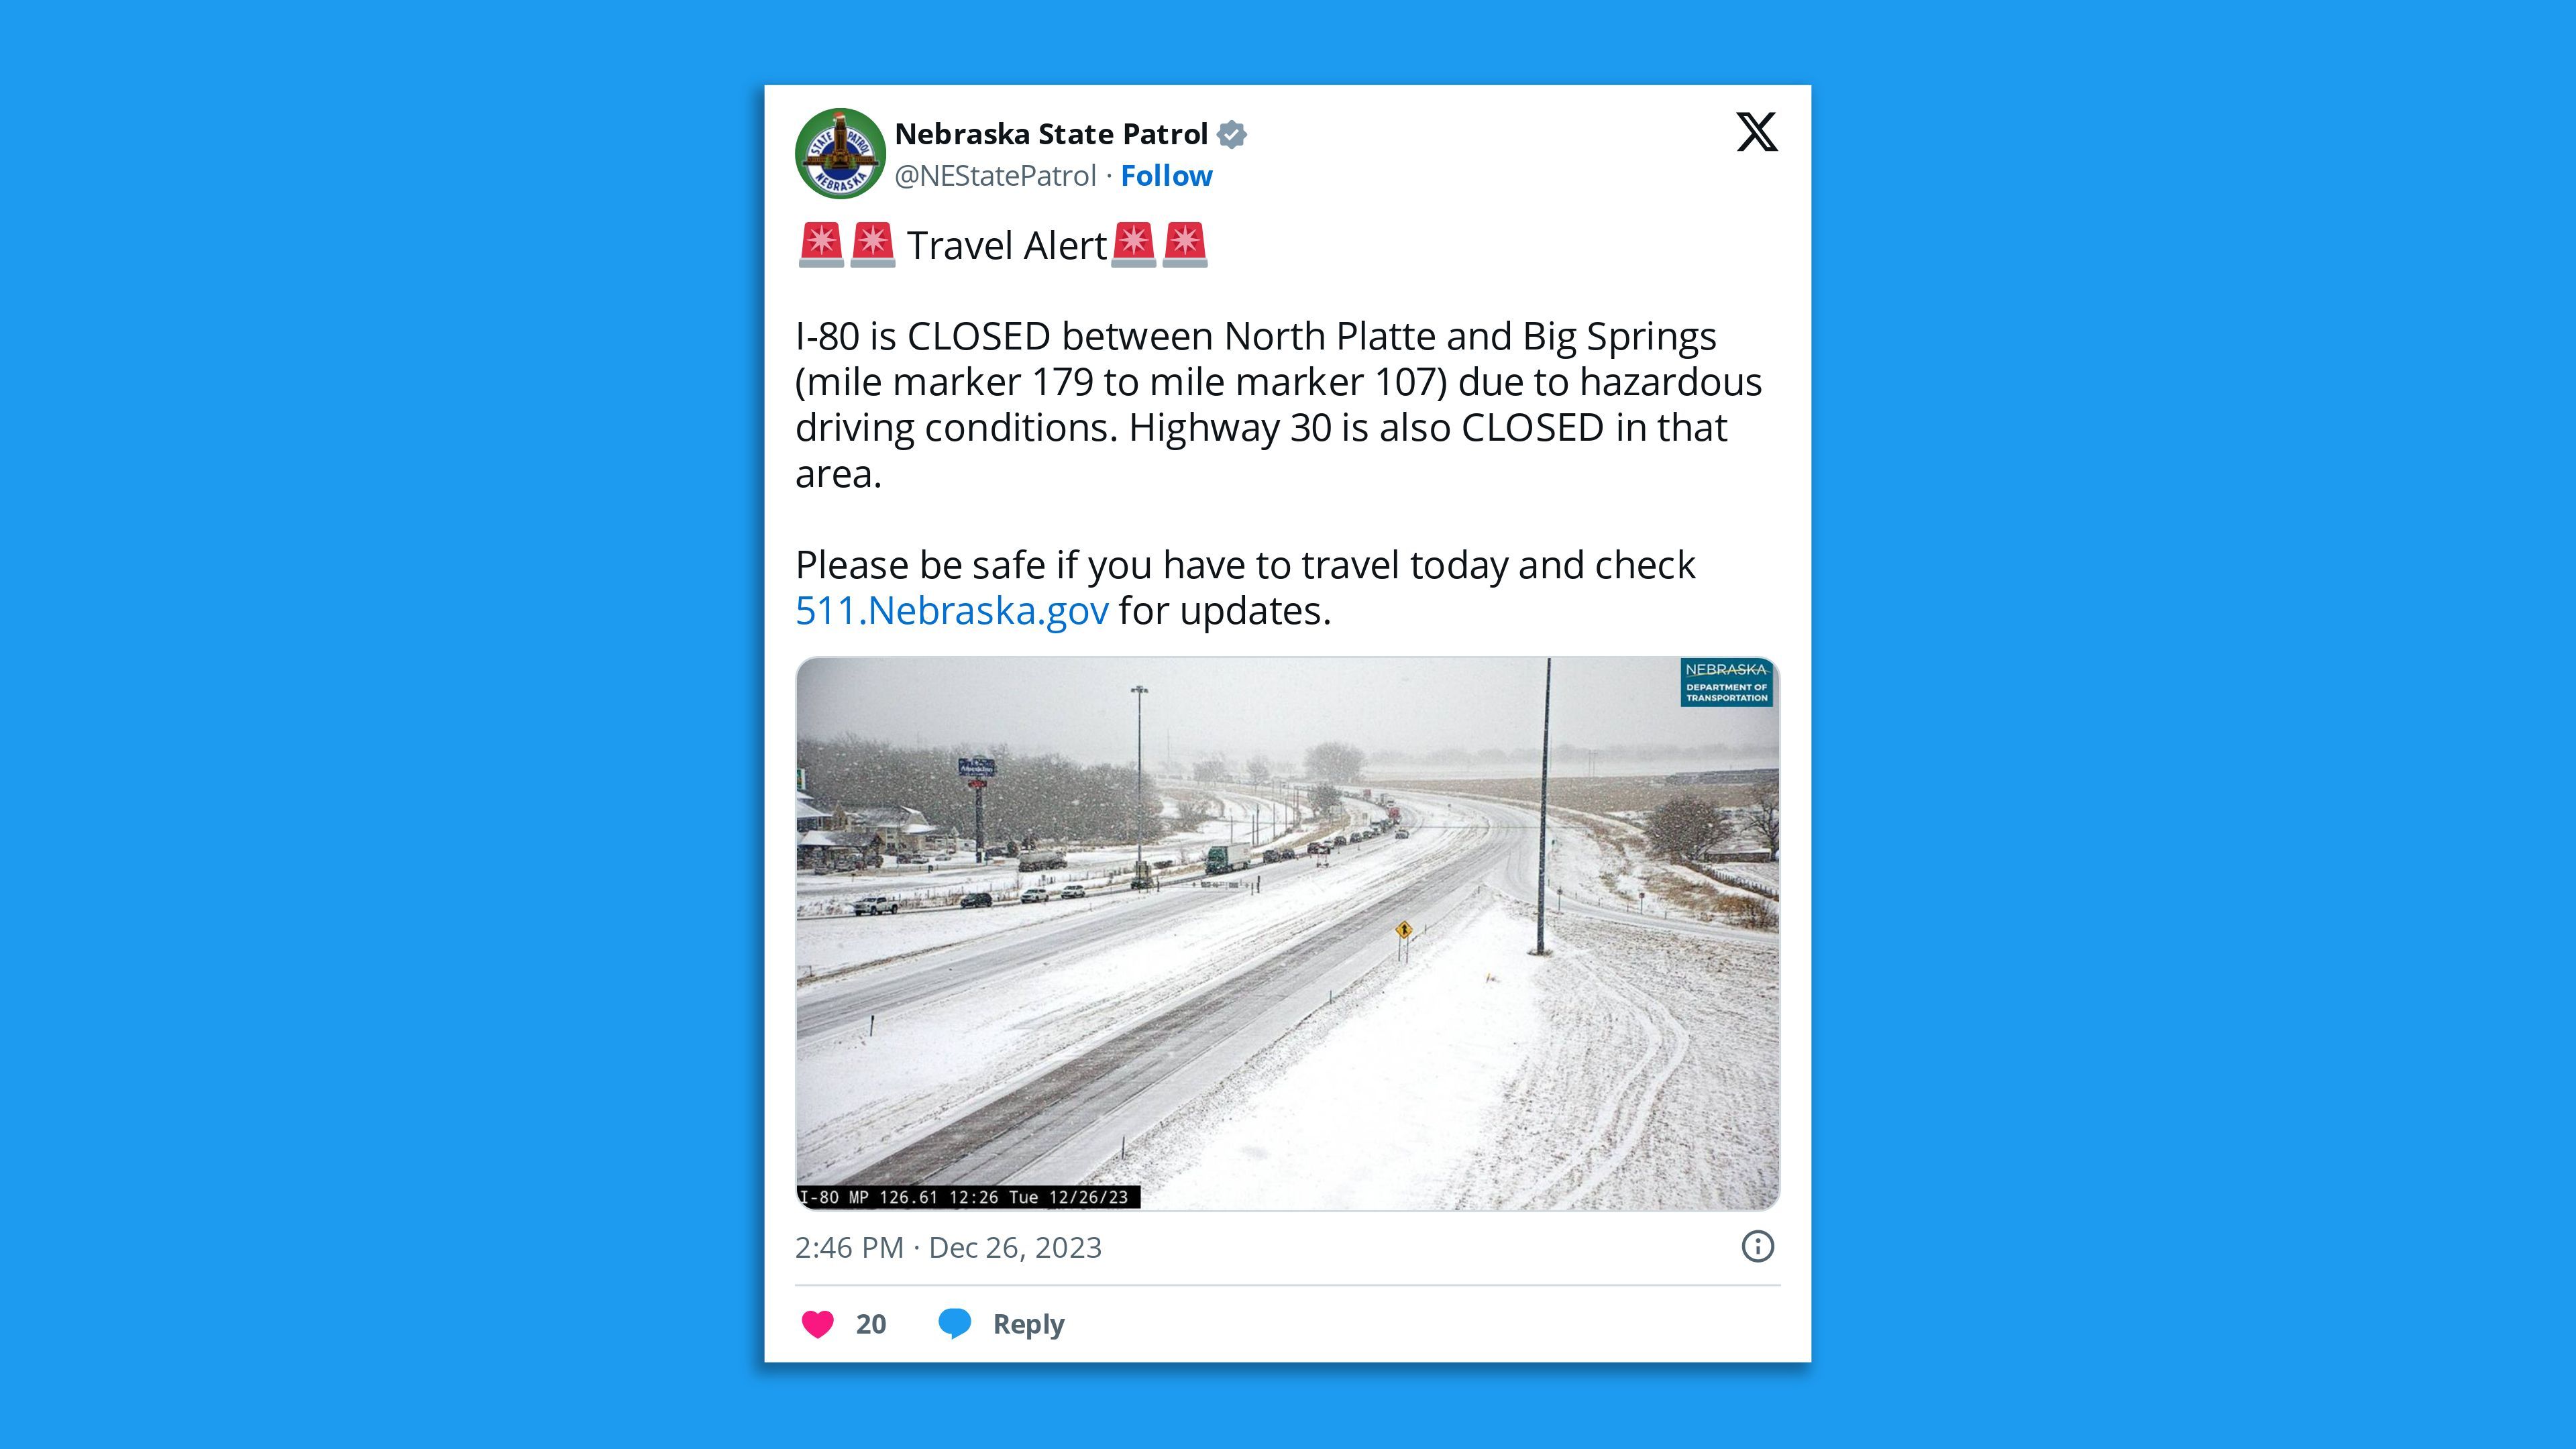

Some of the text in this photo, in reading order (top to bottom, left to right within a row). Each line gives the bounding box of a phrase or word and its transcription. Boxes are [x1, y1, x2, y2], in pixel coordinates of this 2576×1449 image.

[812, 131, 833, 154] STATE
[848, 131, 870, 154] PATROL
[897, 122, 1207, 144] Nebraska State Patrol
[815, 172, 867, 191] NEBRASKA
[896, 164, 1213, 189] @NEStatePatrol Follow
[907, 230, 1107, 260] Travel Alert
[798, 321, 1716, 359] I-80 is CLOSED between North Platte and Big Springs
[796, 366, 1762, 401] (mile marker 179 to mile marker 107) due to hazardous
[797, 412, 1727, 450] driving conditions. Highway 30 is also CLOSED in that
[796, 466, 880, 488] area.
[798, 549, 1696, 588] Please be safe if you have to travel today and check
[797, 595, 1330, 633] 511.Nebraska.gov for updates.
[796, 1237, 1101, 1262] 2:46 PM Dec 26, 2023
[857, 1314, 886, 1334] 20
[995, 1313, 1065, 1340] Reply
